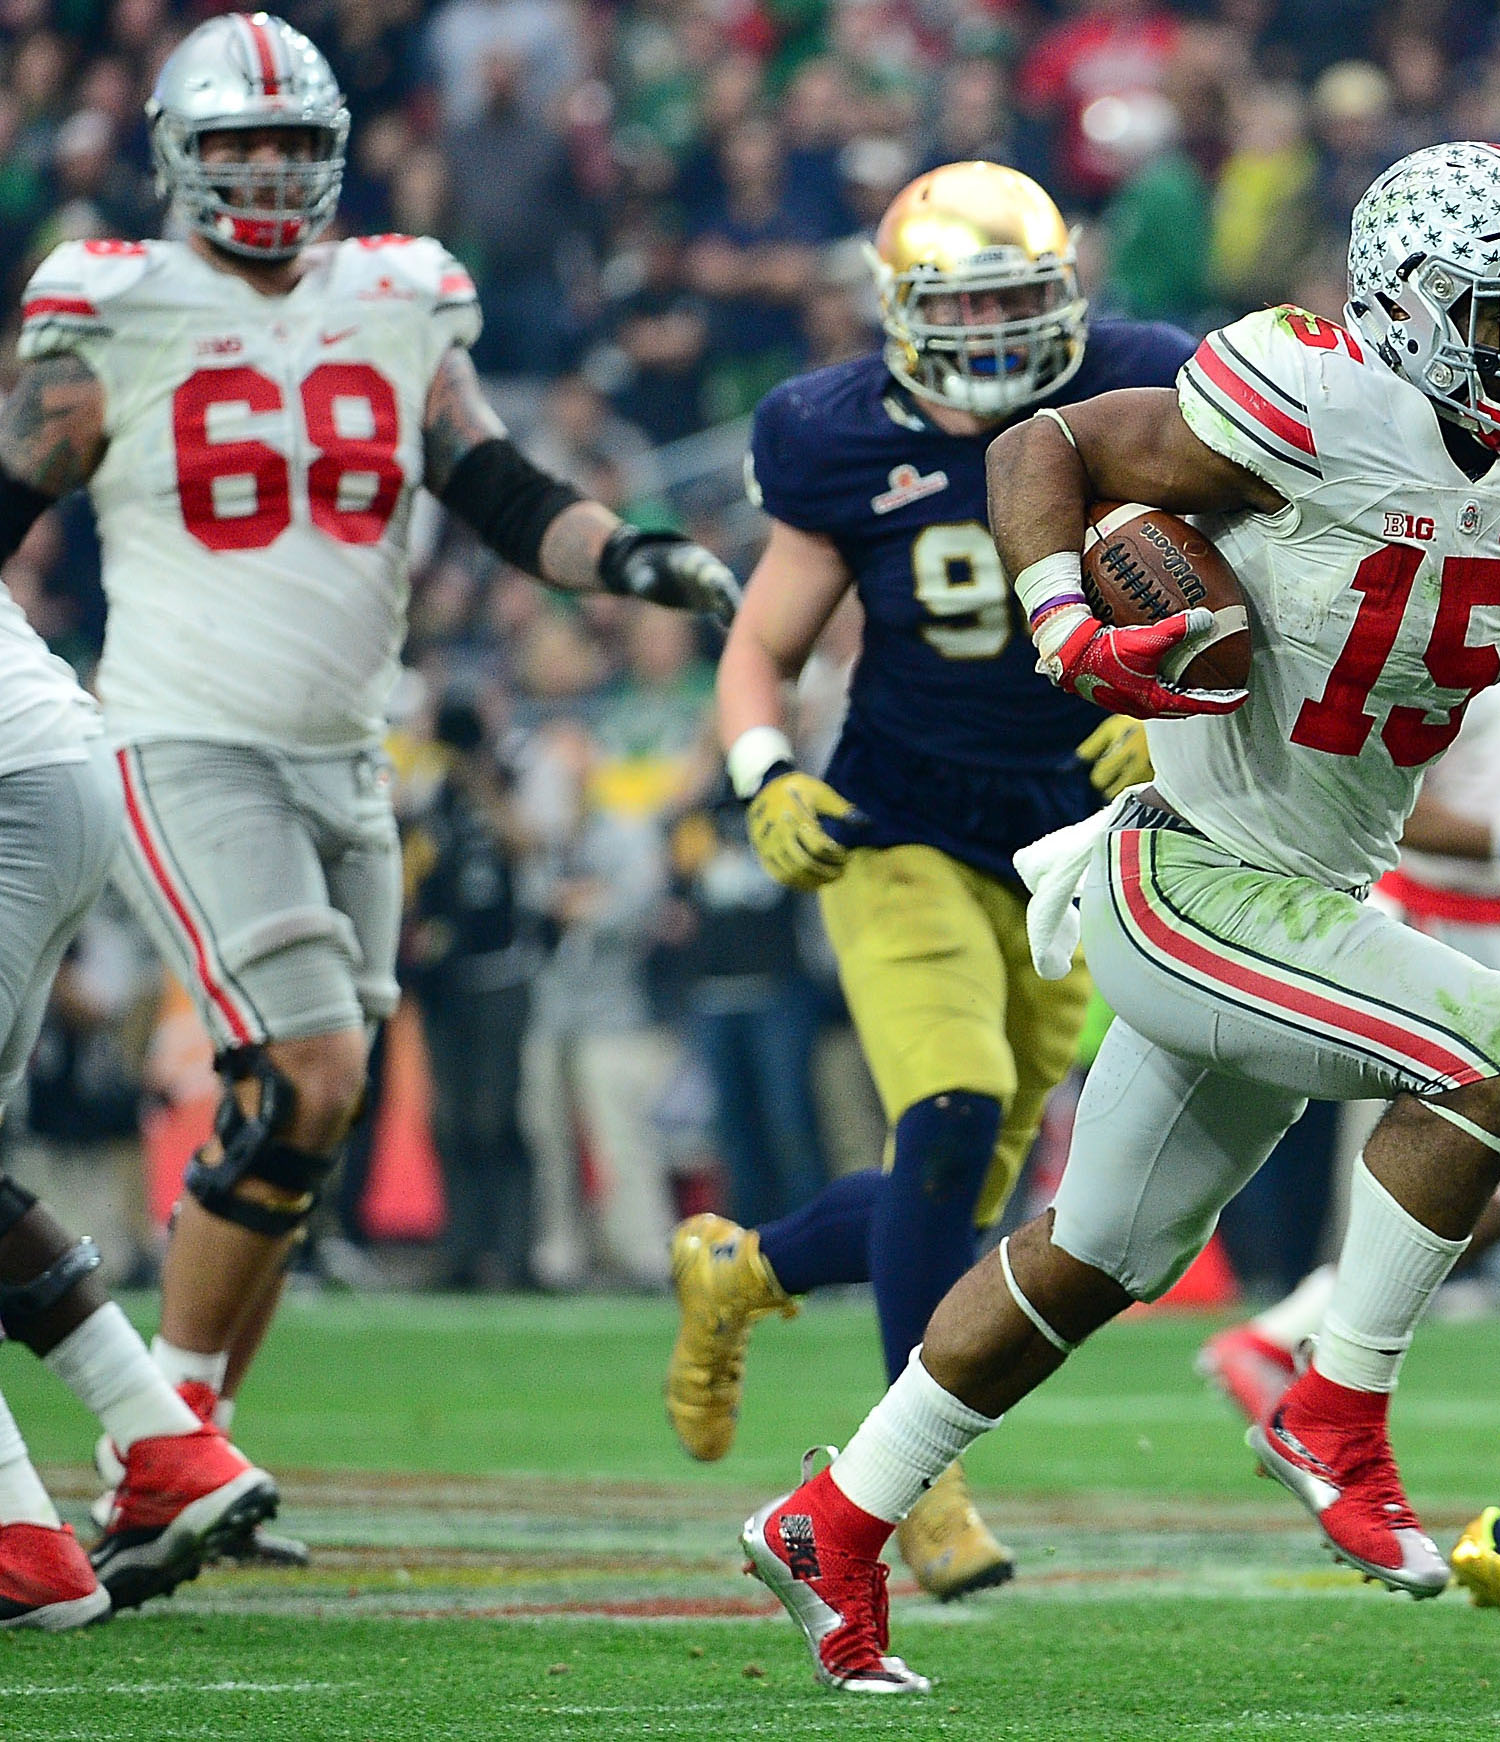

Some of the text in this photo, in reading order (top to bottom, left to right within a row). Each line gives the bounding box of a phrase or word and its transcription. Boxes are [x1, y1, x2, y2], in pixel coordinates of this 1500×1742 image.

[173, 363, 405, 552] 68
[912, 519, 1011, 661] 9
[1138, 519, 1209, 609] Wilson
